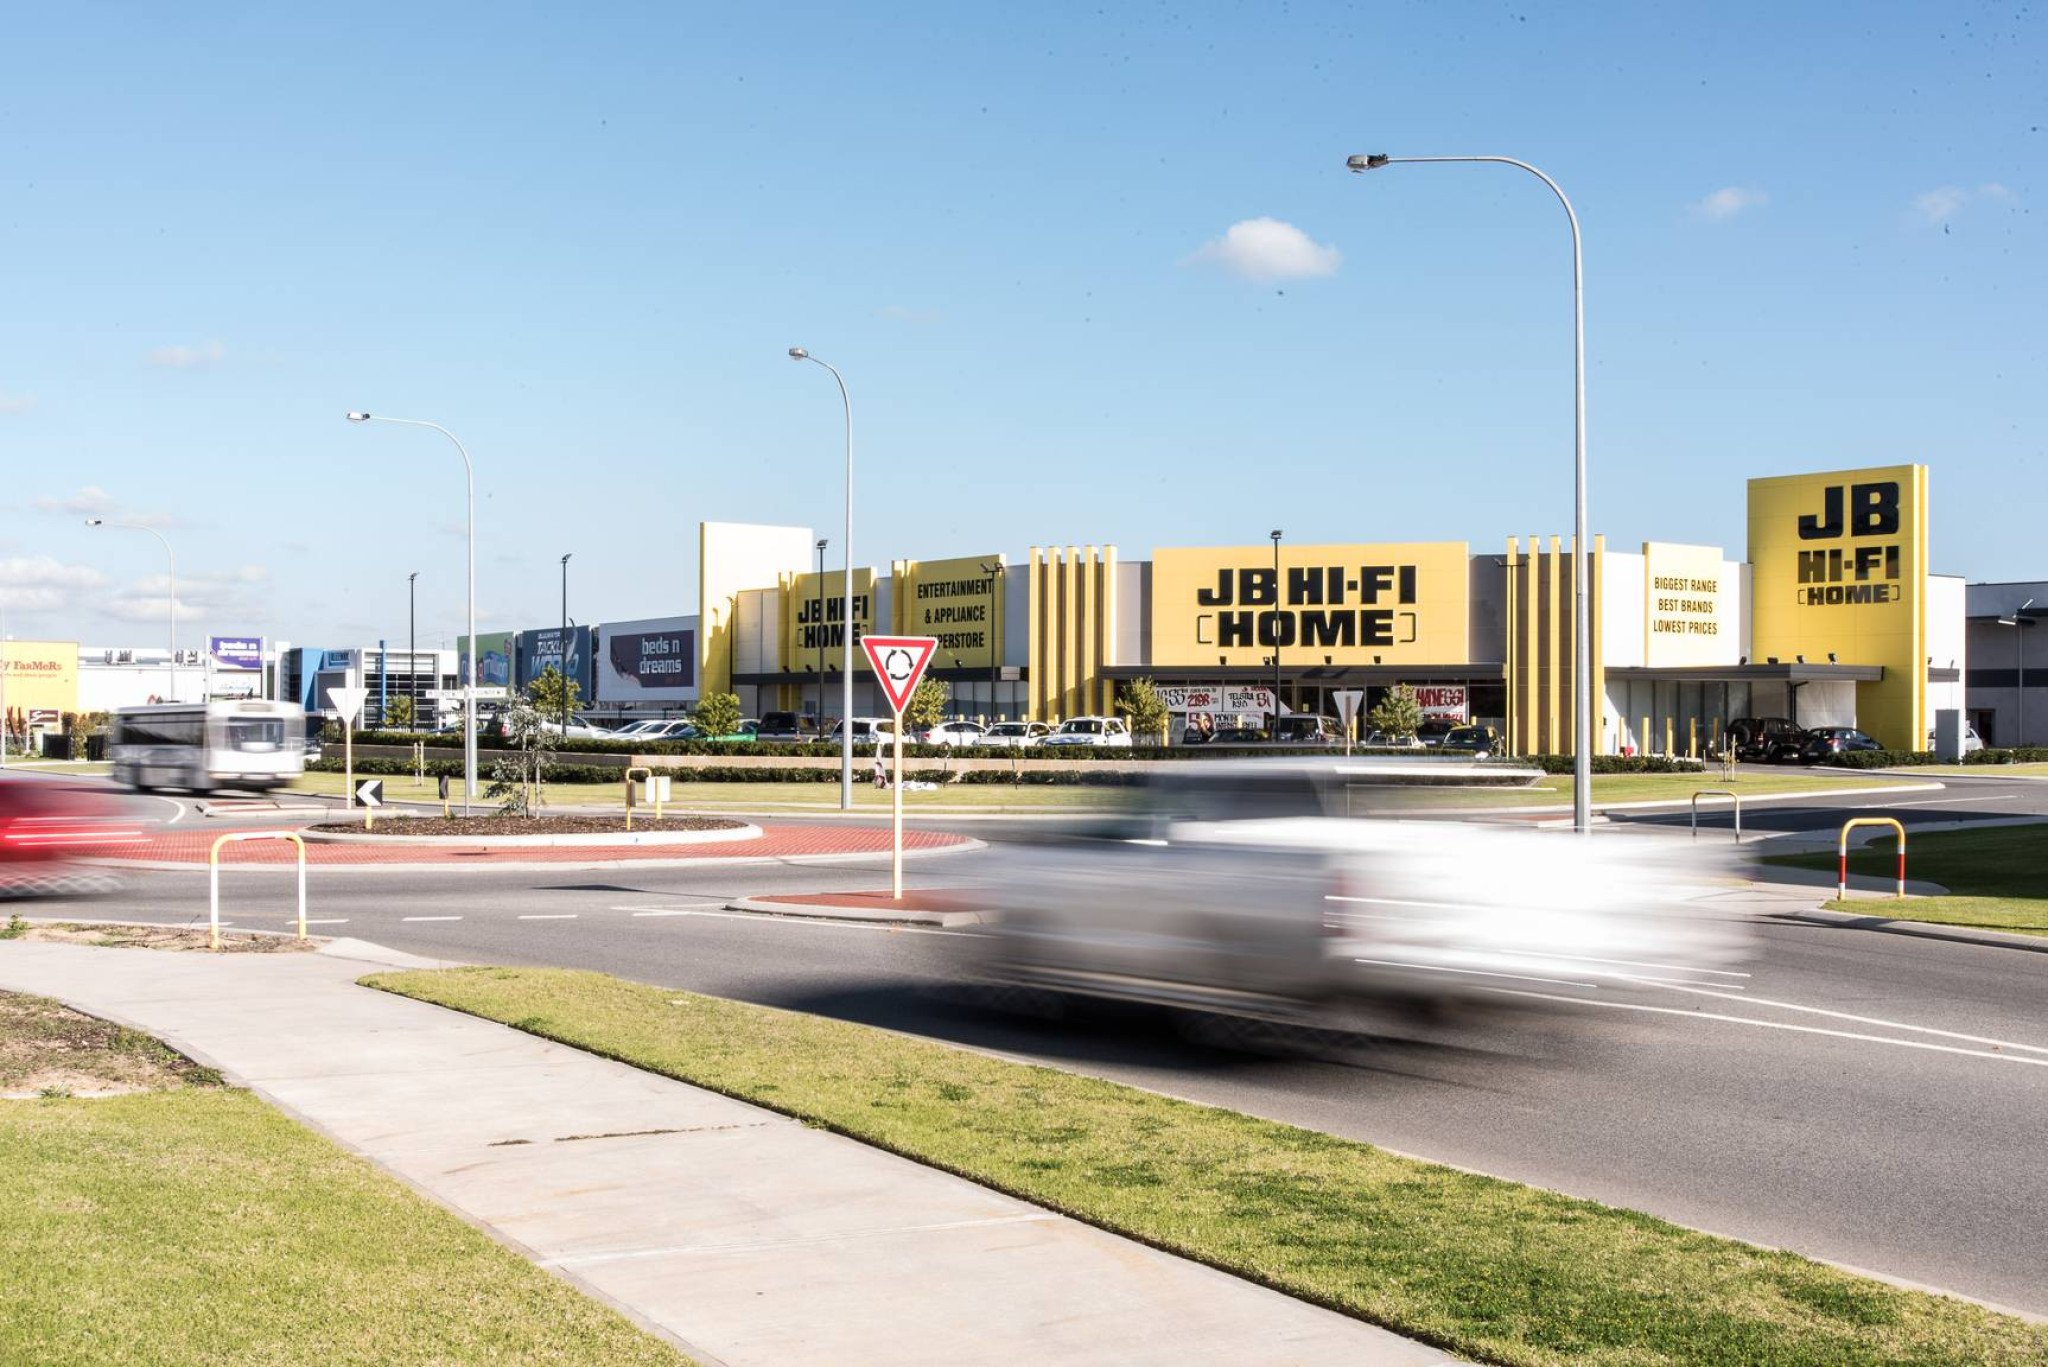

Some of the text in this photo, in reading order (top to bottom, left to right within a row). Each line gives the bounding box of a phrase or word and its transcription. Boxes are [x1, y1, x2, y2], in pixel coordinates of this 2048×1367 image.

[1798, 481, 1899, 540] JB
[1798, 545, 1899, 583] HI-FI
[917, 578, 993, 599] ENTERTAINMENT
[1197, 565, 1416, 606] JB HI-FI
[1654, 576, 1717, 593] BIGGEST RANGE
[798, 595, 868, 623] JB HIFI
[925, 604, 985, 624] & APPLIANCE
[1658, 599, 1713, 614] BEST BRANDS
[1653, 619, 1718, 636] LOWEST PRICES
[642, 636, 680, 655] beds n
[926, 631, 984, 649] PERSTORE
[640, 656, 682, 674] dreams
